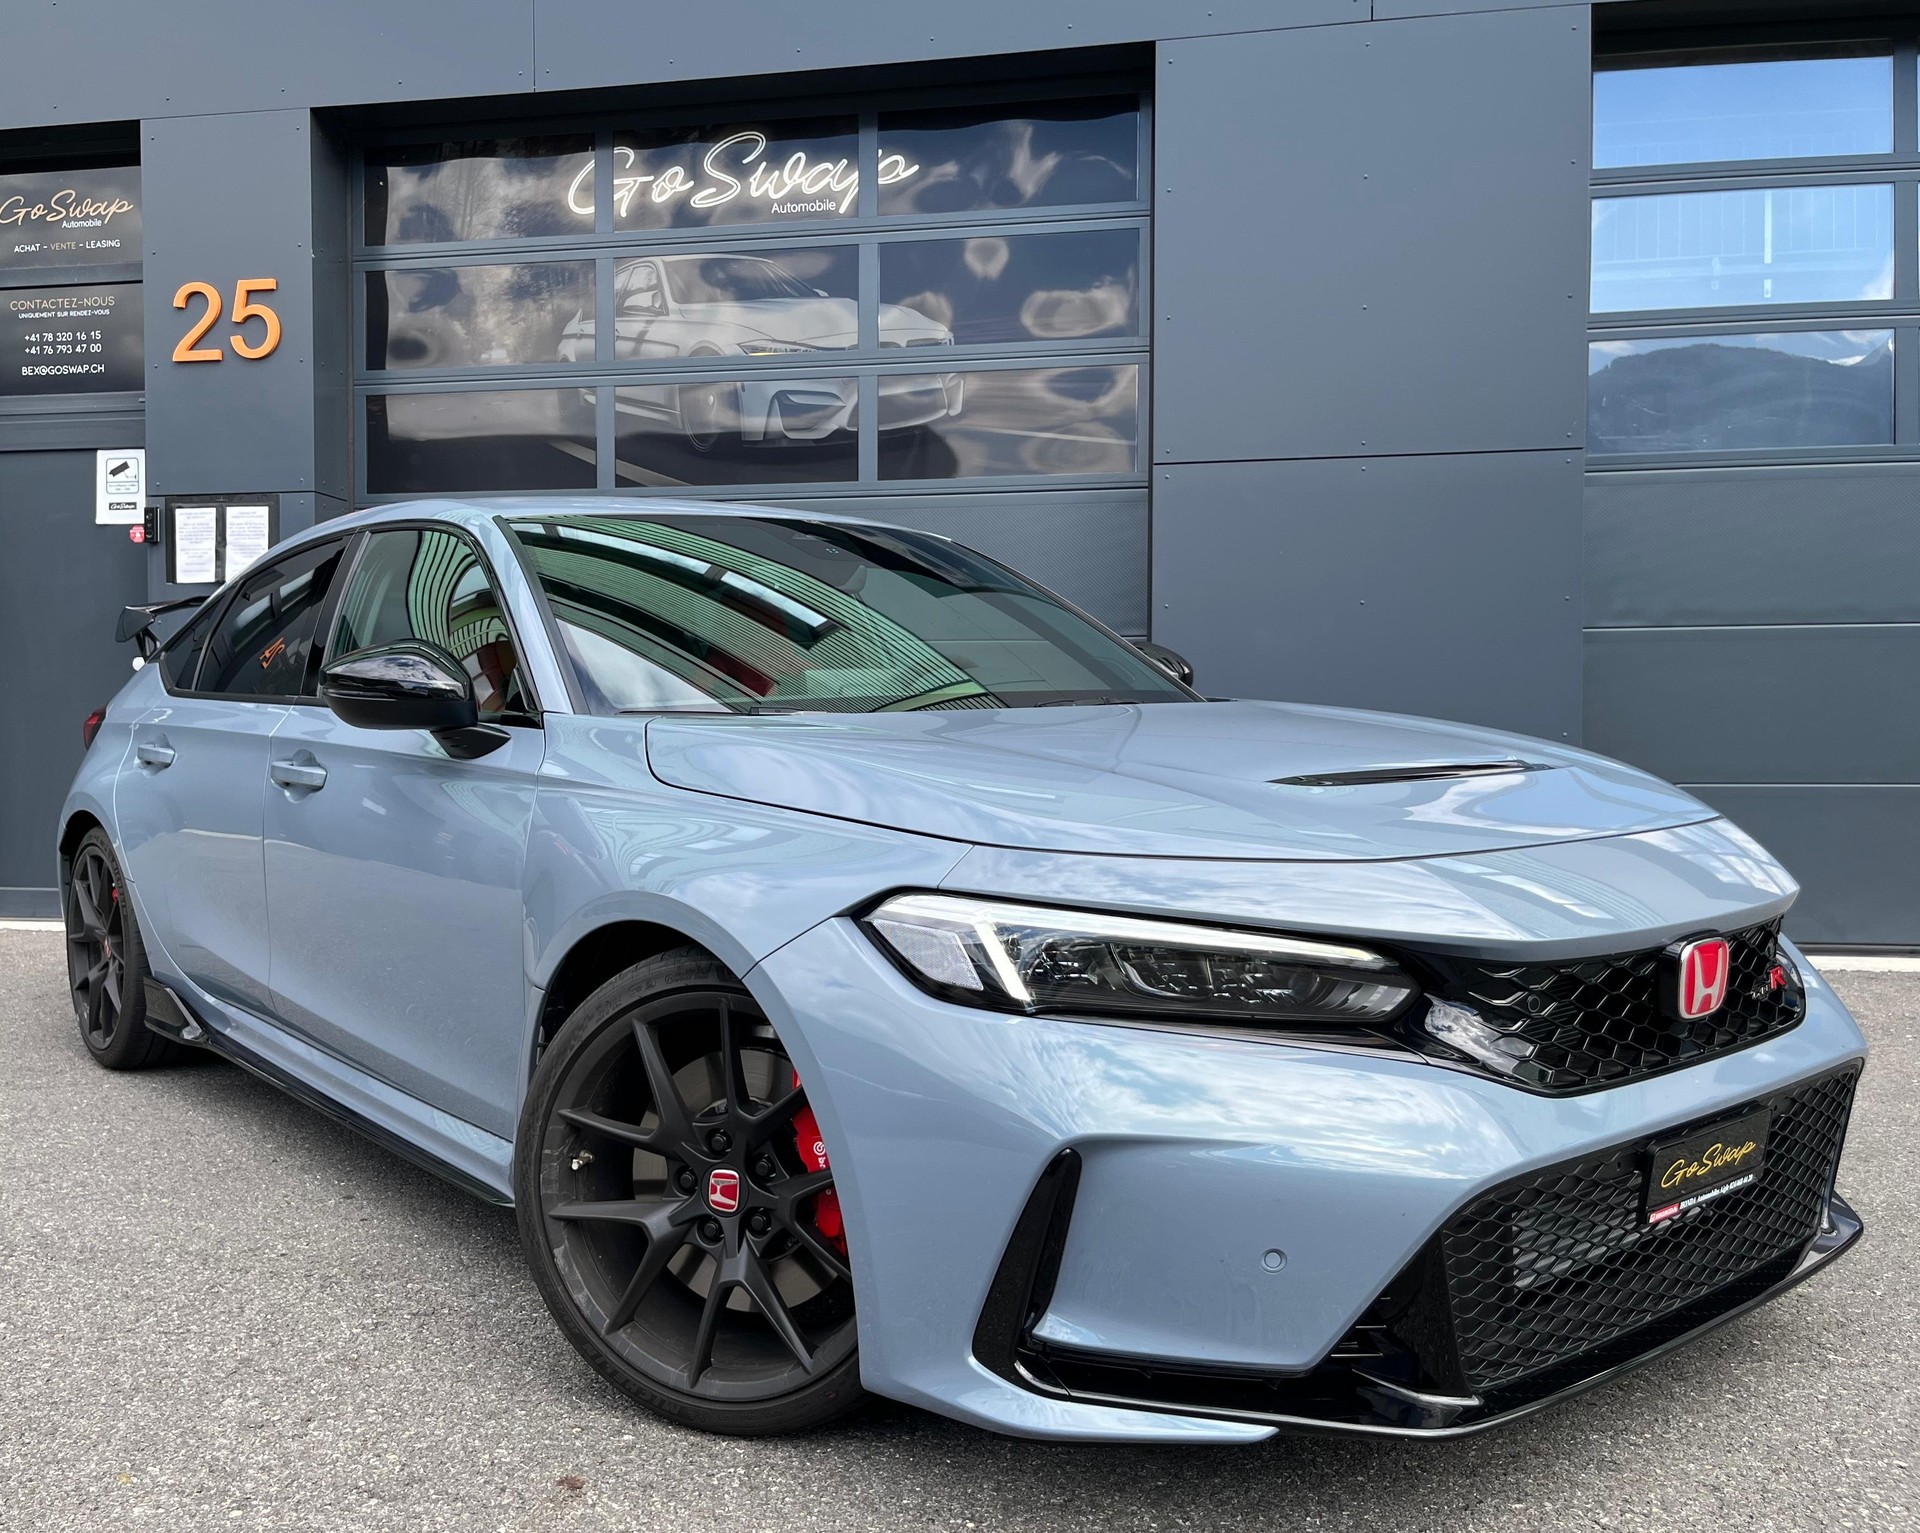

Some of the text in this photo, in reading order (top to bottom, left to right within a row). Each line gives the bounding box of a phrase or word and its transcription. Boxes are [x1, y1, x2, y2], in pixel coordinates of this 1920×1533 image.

[771, 199, 837, 215] Automobile
[62, 218, 103, 229] Automobile
[14, 243, 41, 253] ACHAT
[50, 241, 77, 251] VENTE
[86, 239, 121, 249] LEASING
[10, 296, 115, 311] CONTACTEZ-NOUS
[19, 311, 55, 319] UNIQUEMENT
[70, 308, 110, 316] RENDEZ-VOUS
[172, 278, 281, 362] 25
[25, 330, 102, 342] +41 78 320 16 15
[25, 343, 102, 355] +41 76 793 47 00
[21, 364, 105, 376] BEX@GOSWAP.CH
